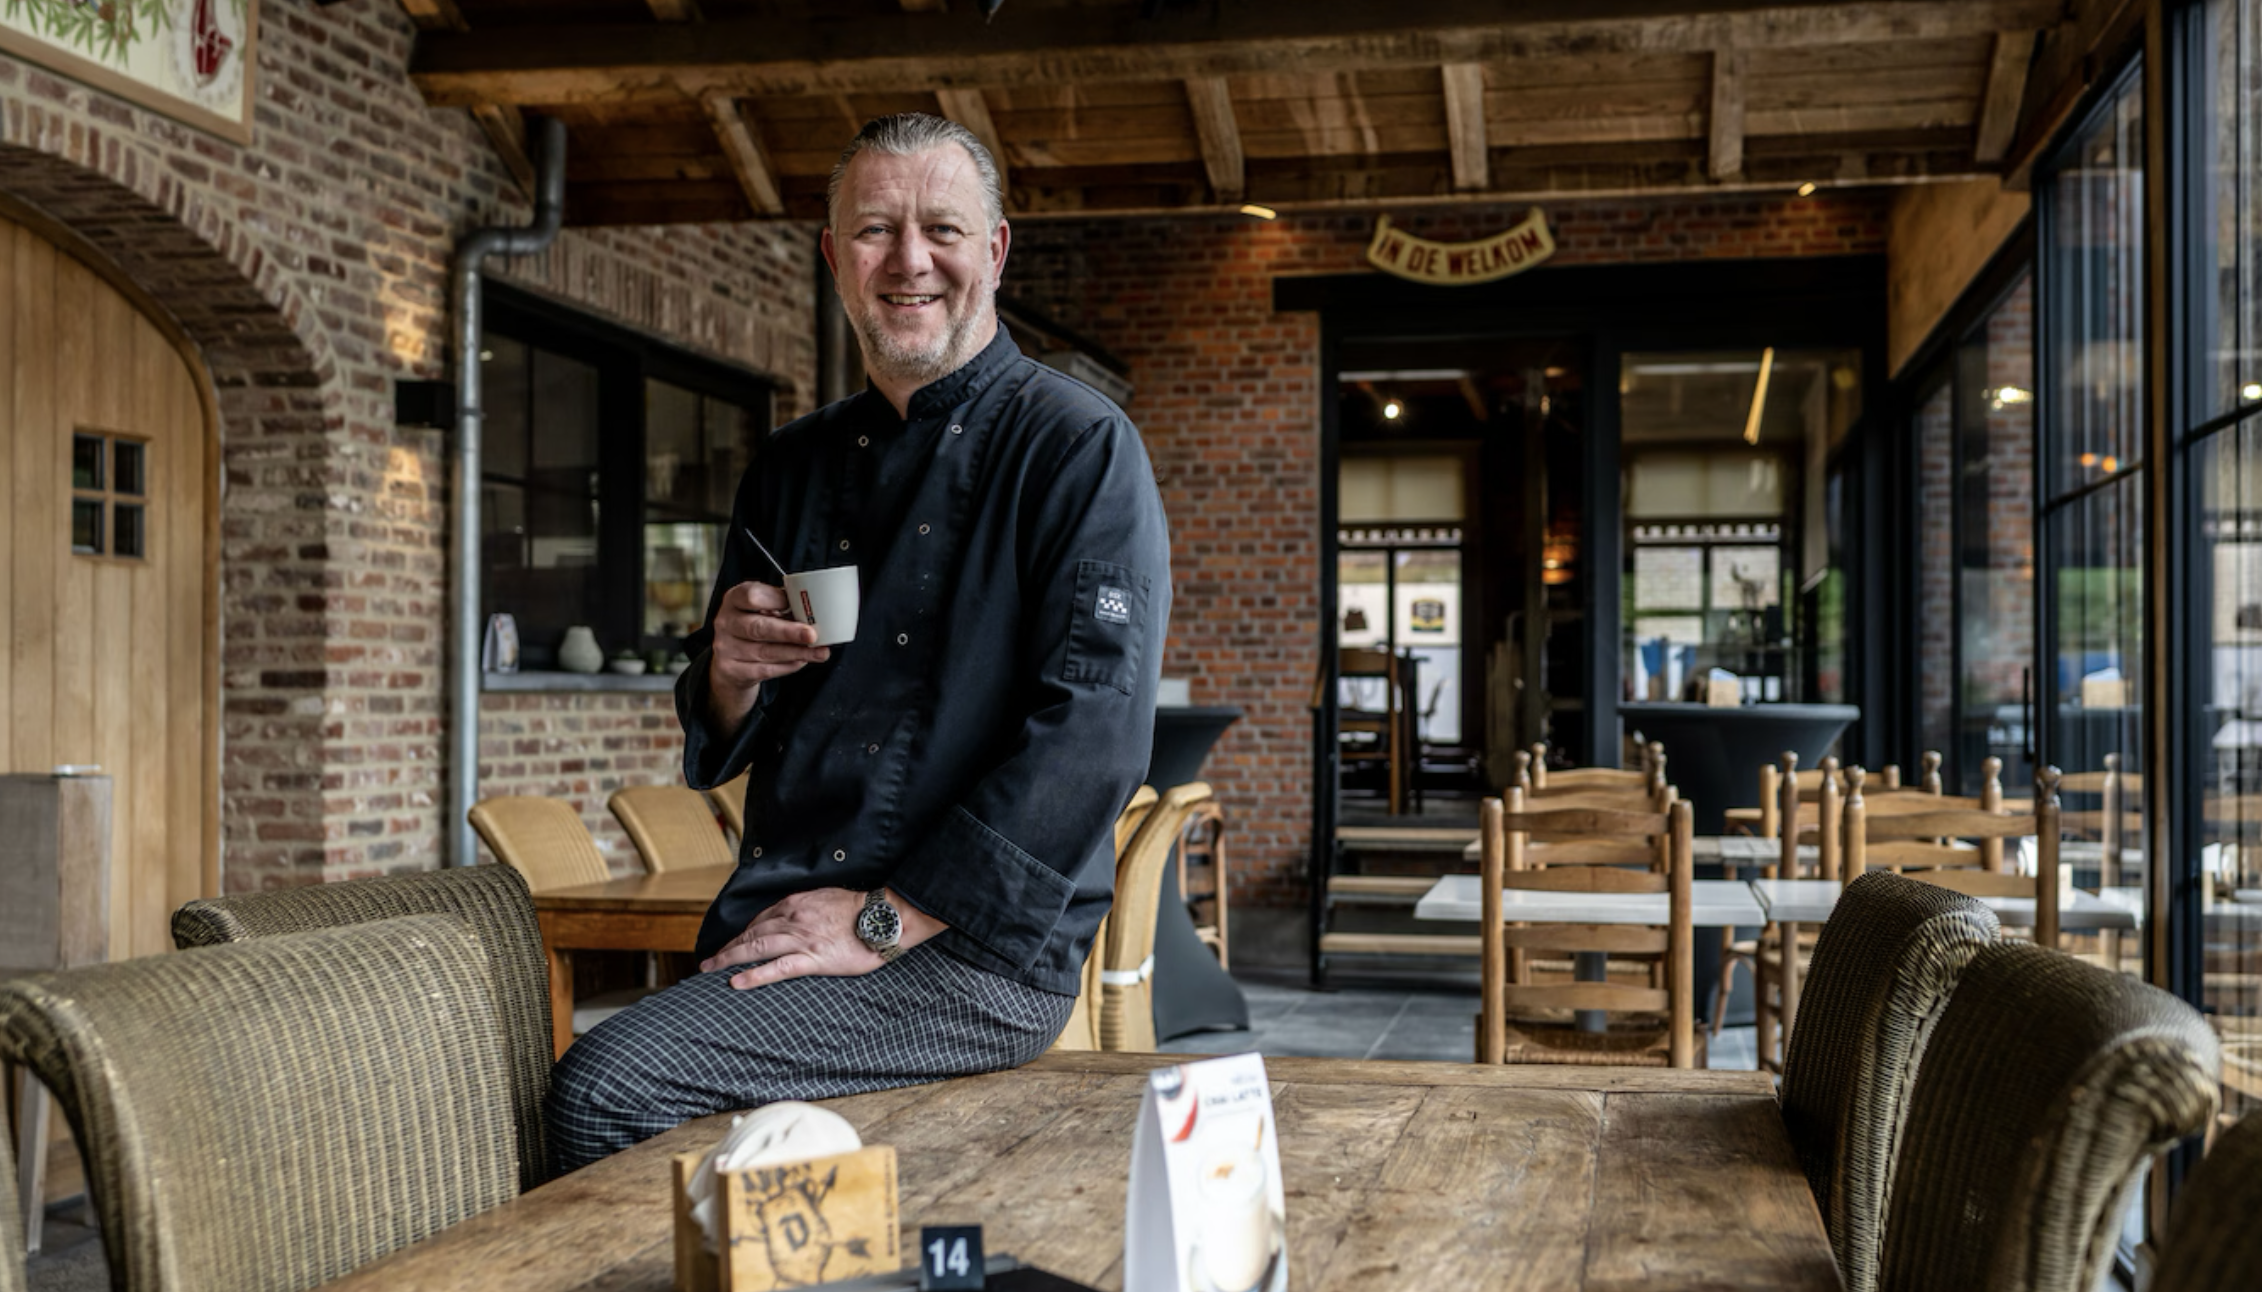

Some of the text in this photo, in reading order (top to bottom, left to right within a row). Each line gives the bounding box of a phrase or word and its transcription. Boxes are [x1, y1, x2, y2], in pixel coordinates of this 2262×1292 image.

[1376, 228, 1544, 276] IN DE WELKOM
[928, 1237, 971, 1279] 14
